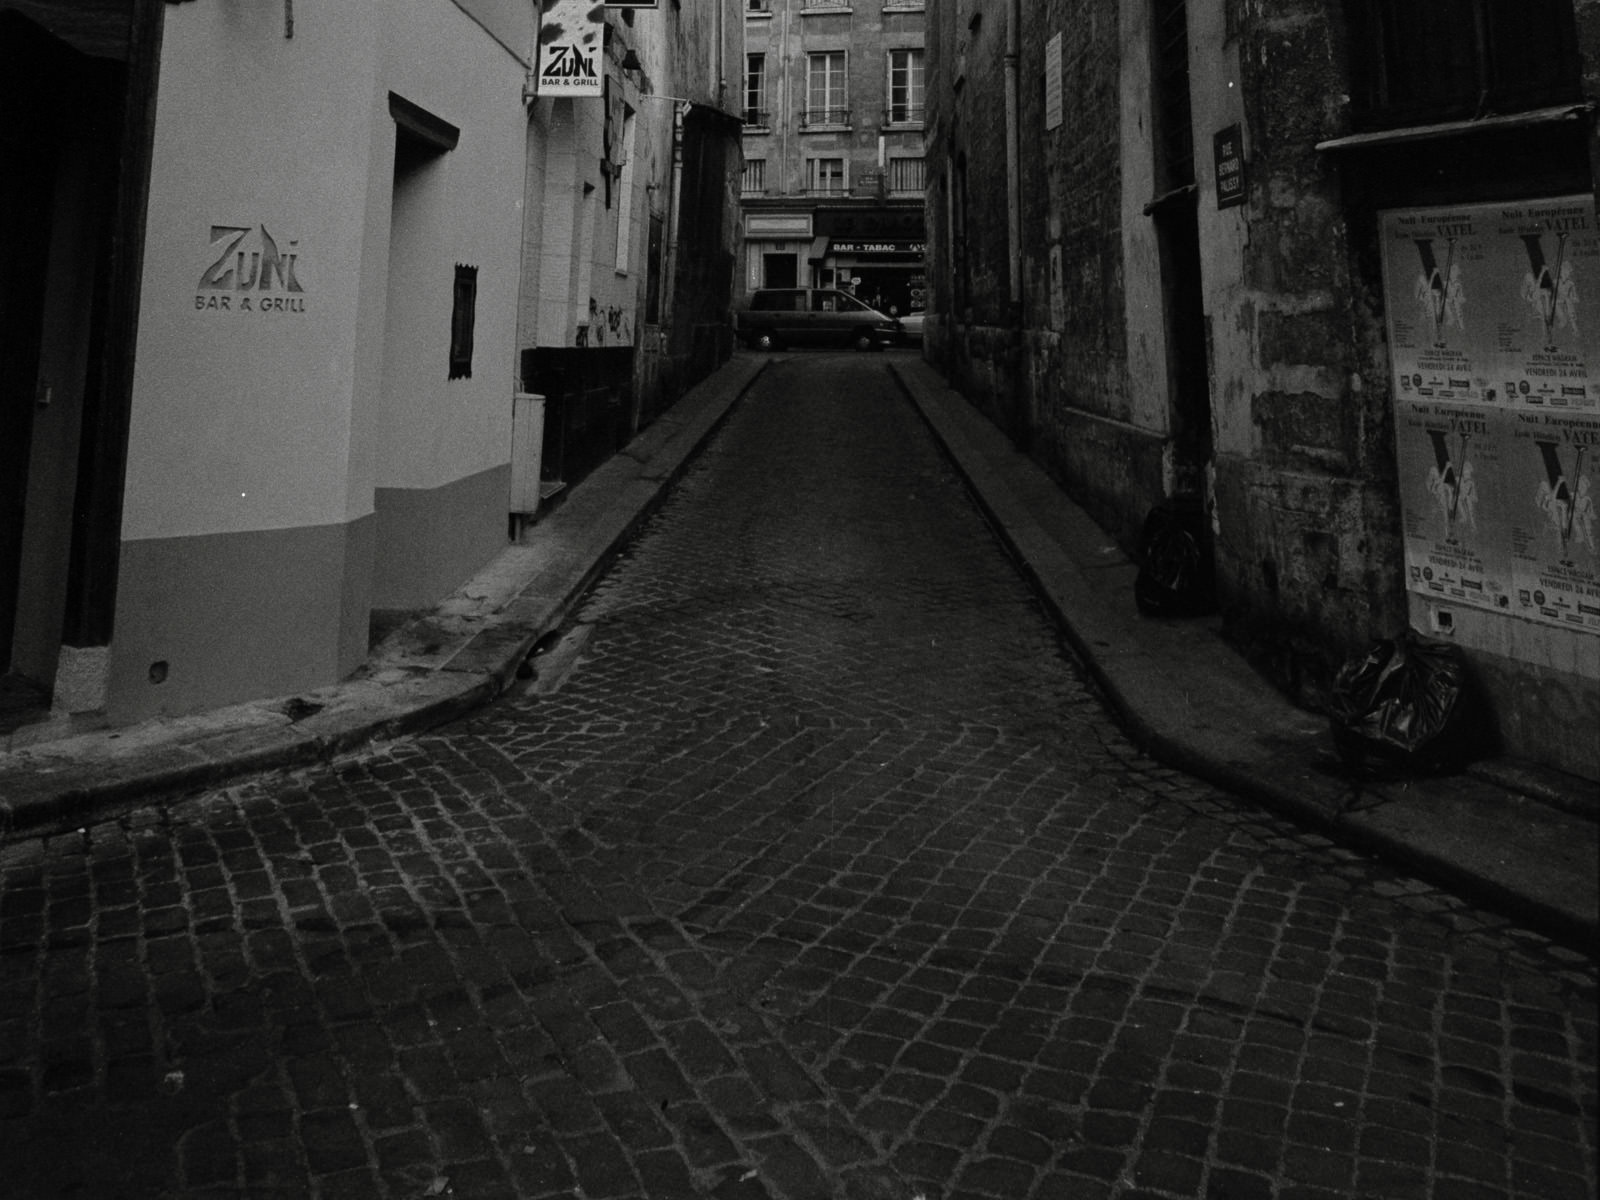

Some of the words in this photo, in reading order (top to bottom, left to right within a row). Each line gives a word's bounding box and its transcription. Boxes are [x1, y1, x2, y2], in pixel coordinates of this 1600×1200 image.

[541, 78, 560, 86] BAR
[563, 78, 570, 86] &
[573, 78, 599, 86] GRILL
[1437, 223, 1477, 237] VATEL
[1545, 216, 1590, 231] VATEL
[833, 243, 854, 251] BAR
[862, 243, 896, 251] TABAC
[195, 295, 231, 311] BAR
[240, 296, 252, 312] &
[260, 297, 305, 312] GRILL
[1449, 418, 1490, 435] VATEL
